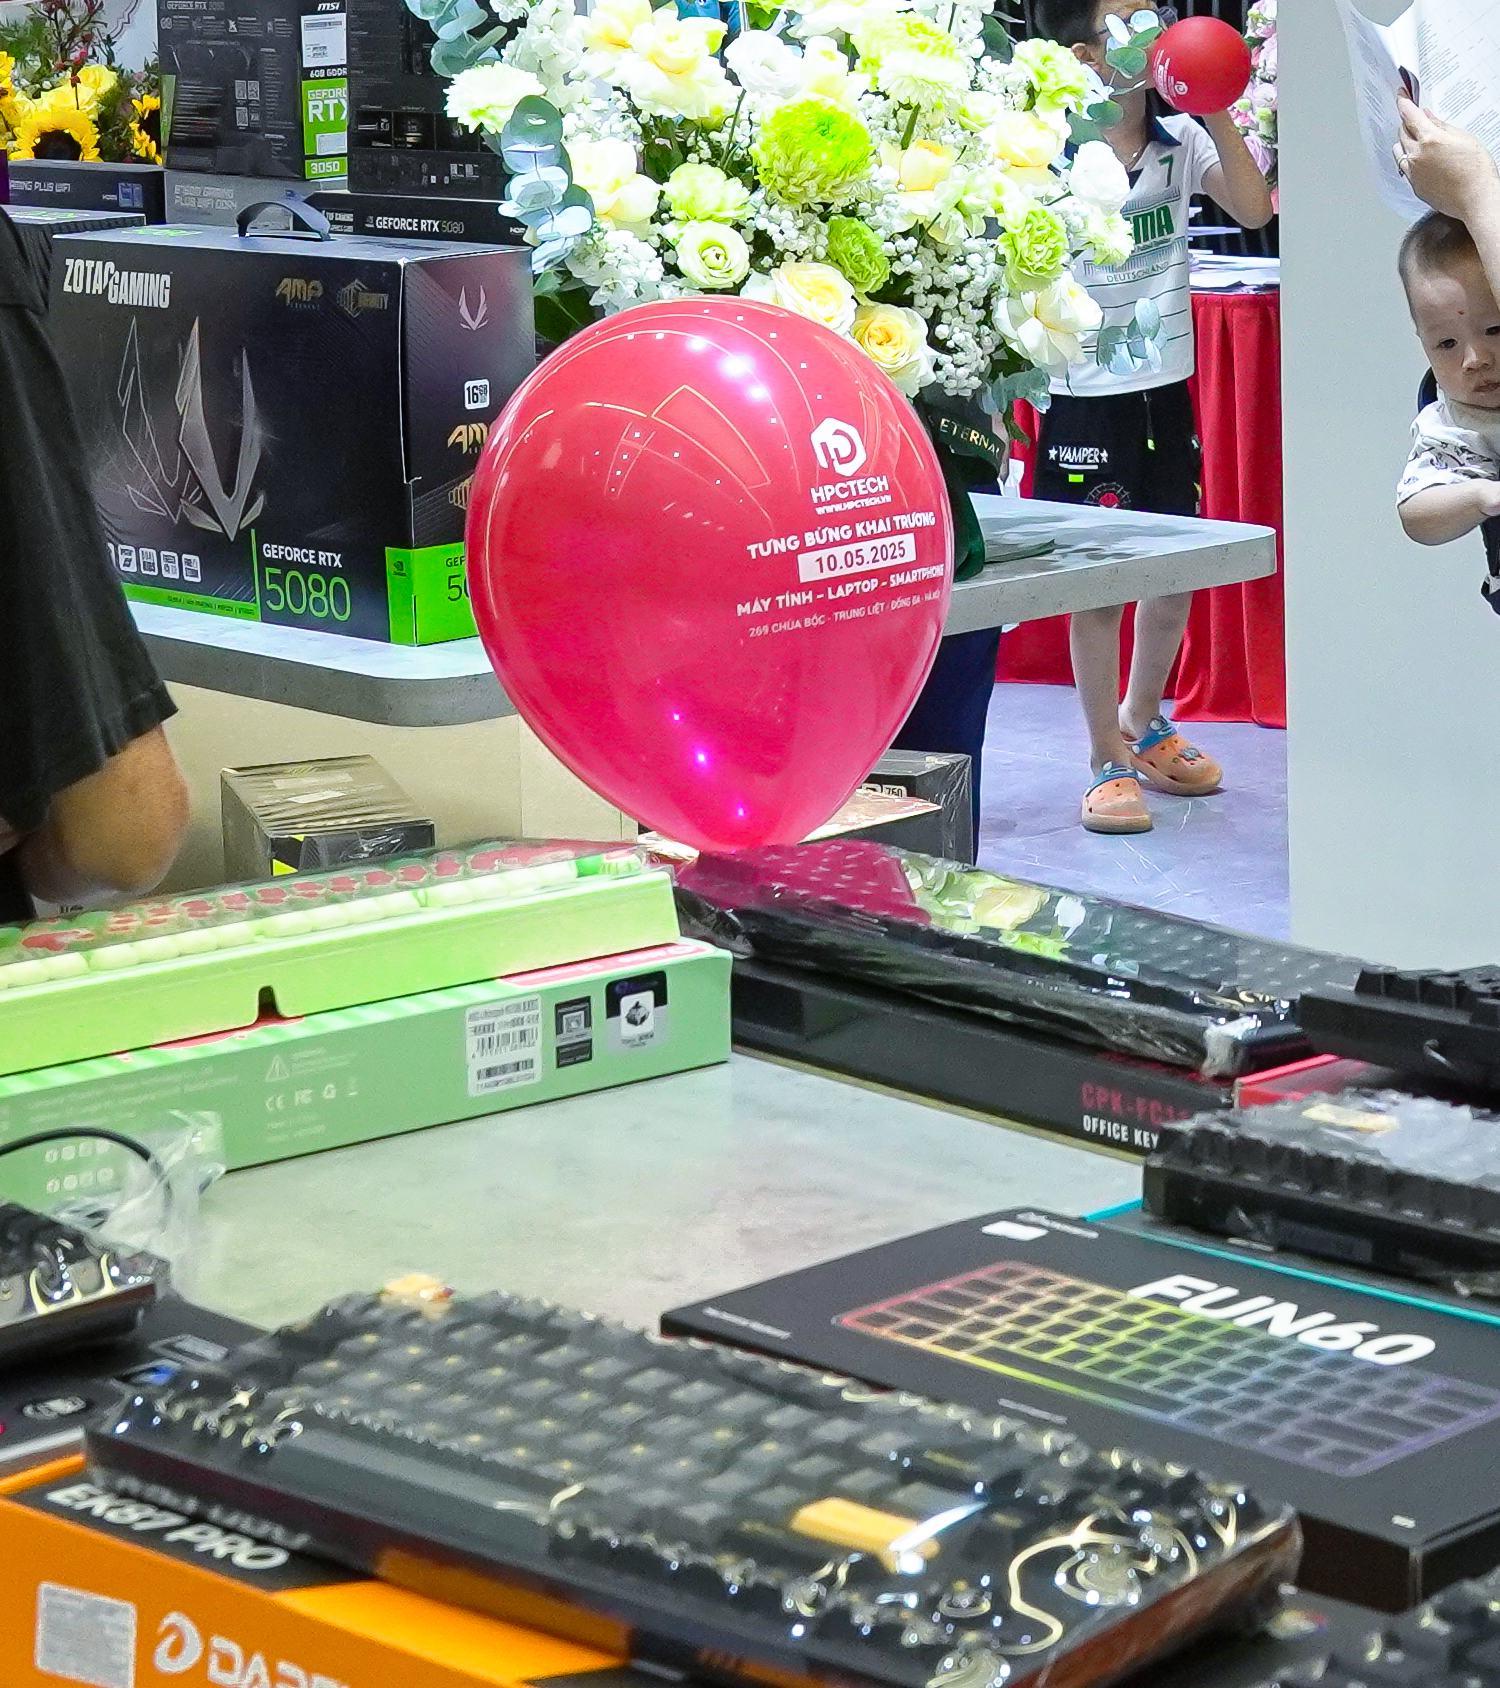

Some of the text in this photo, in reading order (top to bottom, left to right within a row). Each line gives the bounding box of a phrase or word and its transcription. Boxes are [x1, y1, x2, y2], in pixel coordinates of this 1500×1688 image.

[311, 161, 340, 174] 3050
[376, 216, 418, 231] GEFORCE
[420, 219, 440, 233] RTX
[63, 258, 171, 309] ZOTAC GAMING
[810, 475, 889, 504] HPCTECH
[855, 517, 892, 538] KHAI
[262, 543, 343, 569] GEFORCE RTX
[815, 540, 907, 574] 10.05.2025
[265, 567, 351, 621] 5080
[737, 562, 944, 617] MÁY TÍNH LAPTOP SMARTPHONE
[833, 606, 866, 623] TRUNG
[1082, 1114, 1160, 1150] OFFICE KEY
[1125, 1273, 1437, 1366] FUN60
[165, 1522, 291, 1569] PRO
